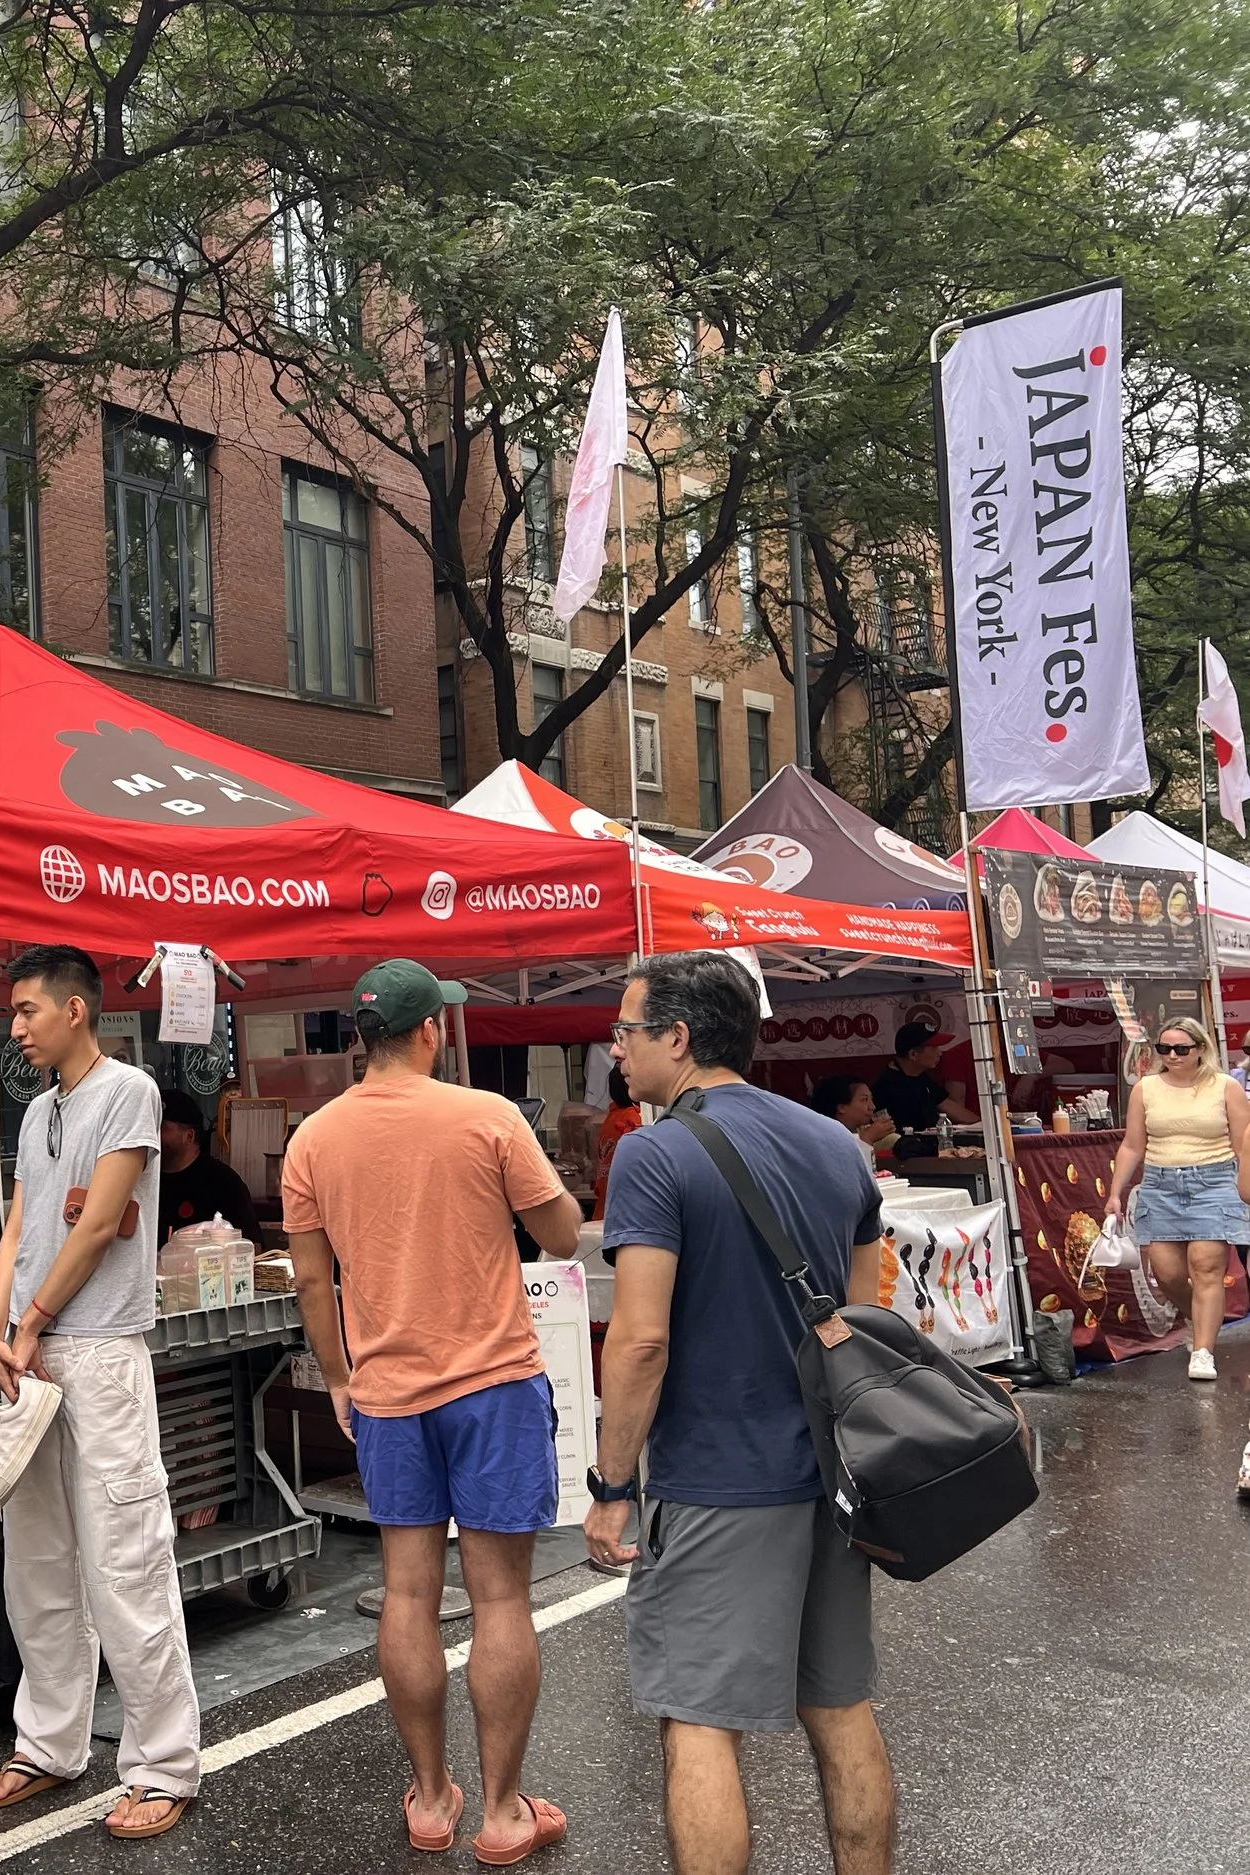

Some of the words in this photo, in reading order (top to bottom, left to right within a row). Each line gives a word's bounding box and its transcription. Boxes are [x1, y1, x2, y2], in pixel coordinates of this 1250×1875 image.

[1012, 346, 1107, 588] JAPAN
[969, 460, 1008, 555] New
[974, 561, 1018, 662] York
[728, 837, 800, 858] BAO
[97, 863, 330, 908] MAOSBAO.COM
[465, 883, 601, 913] @MAOSBAO
[734, 905, 771, 920] Sweet
[768, 908, 806, 921] Crunch
[846, 912, 896, 930] HANDMADE
[896, 919, 941, 936] HAPPINESS
[744, 919, 820, 939] Tanghulu
[101, 1015, 134, 1024] NSIONS
